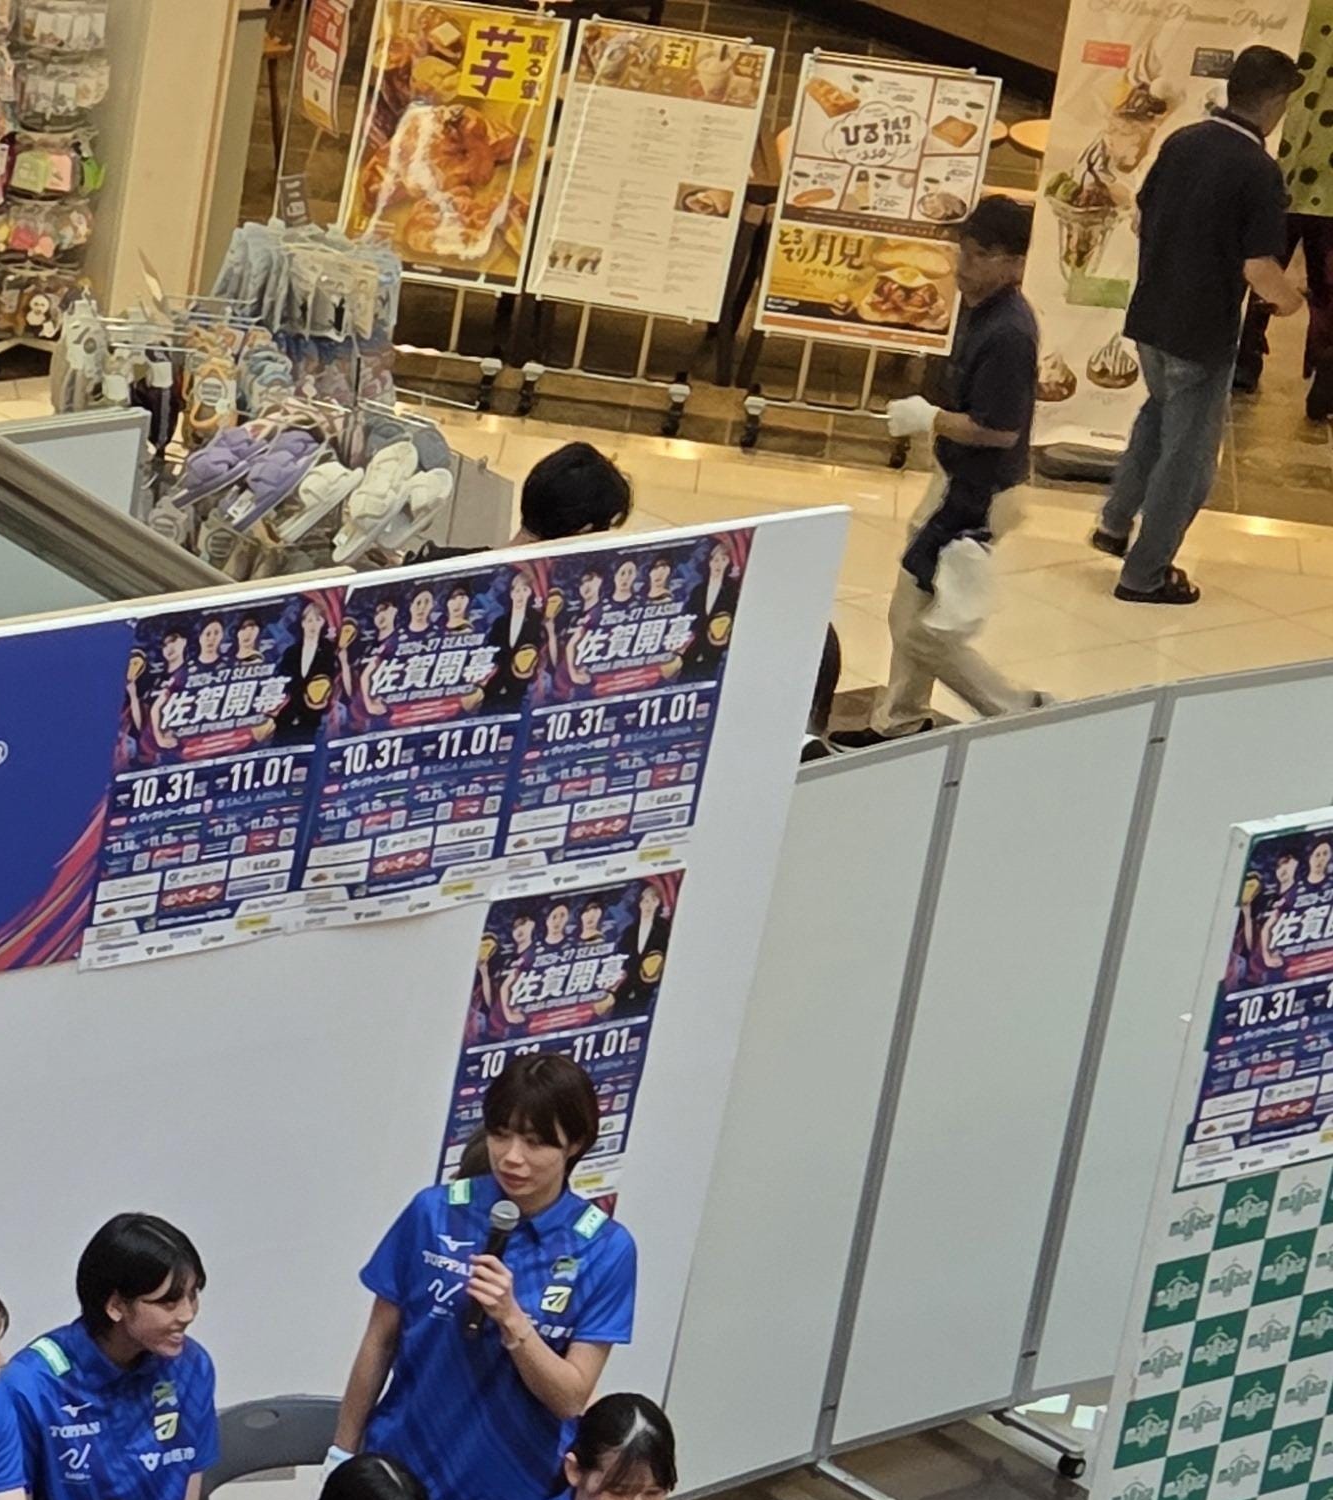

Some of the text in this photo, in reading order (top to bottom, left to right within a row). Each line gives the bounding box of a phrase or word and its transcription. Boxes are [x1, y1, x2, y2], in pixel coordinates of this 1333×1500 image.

[806, 232, 864, 269] 月見
[574, 615, 698, 665] 佐賀開幕
[370, 646, 498, 696] 佐賀開幕
[159, 676, 290, 729] 佐賀開幕
[637, 692, 698, 727] 11.01
[438, 724, 500, 761] 11.01
[545, 706, 607, 742] 10.31
[230, 755, 294, 792] 11.01
[342, 739, 406, 775] 10.31
[131, 771, 196, 808] 10.31
[508, 954, 629, 1005] 佐賀開幕
[1237, 989, 1297, 1027] 10.31
[571, 1027, 630, 1062] 11.01
